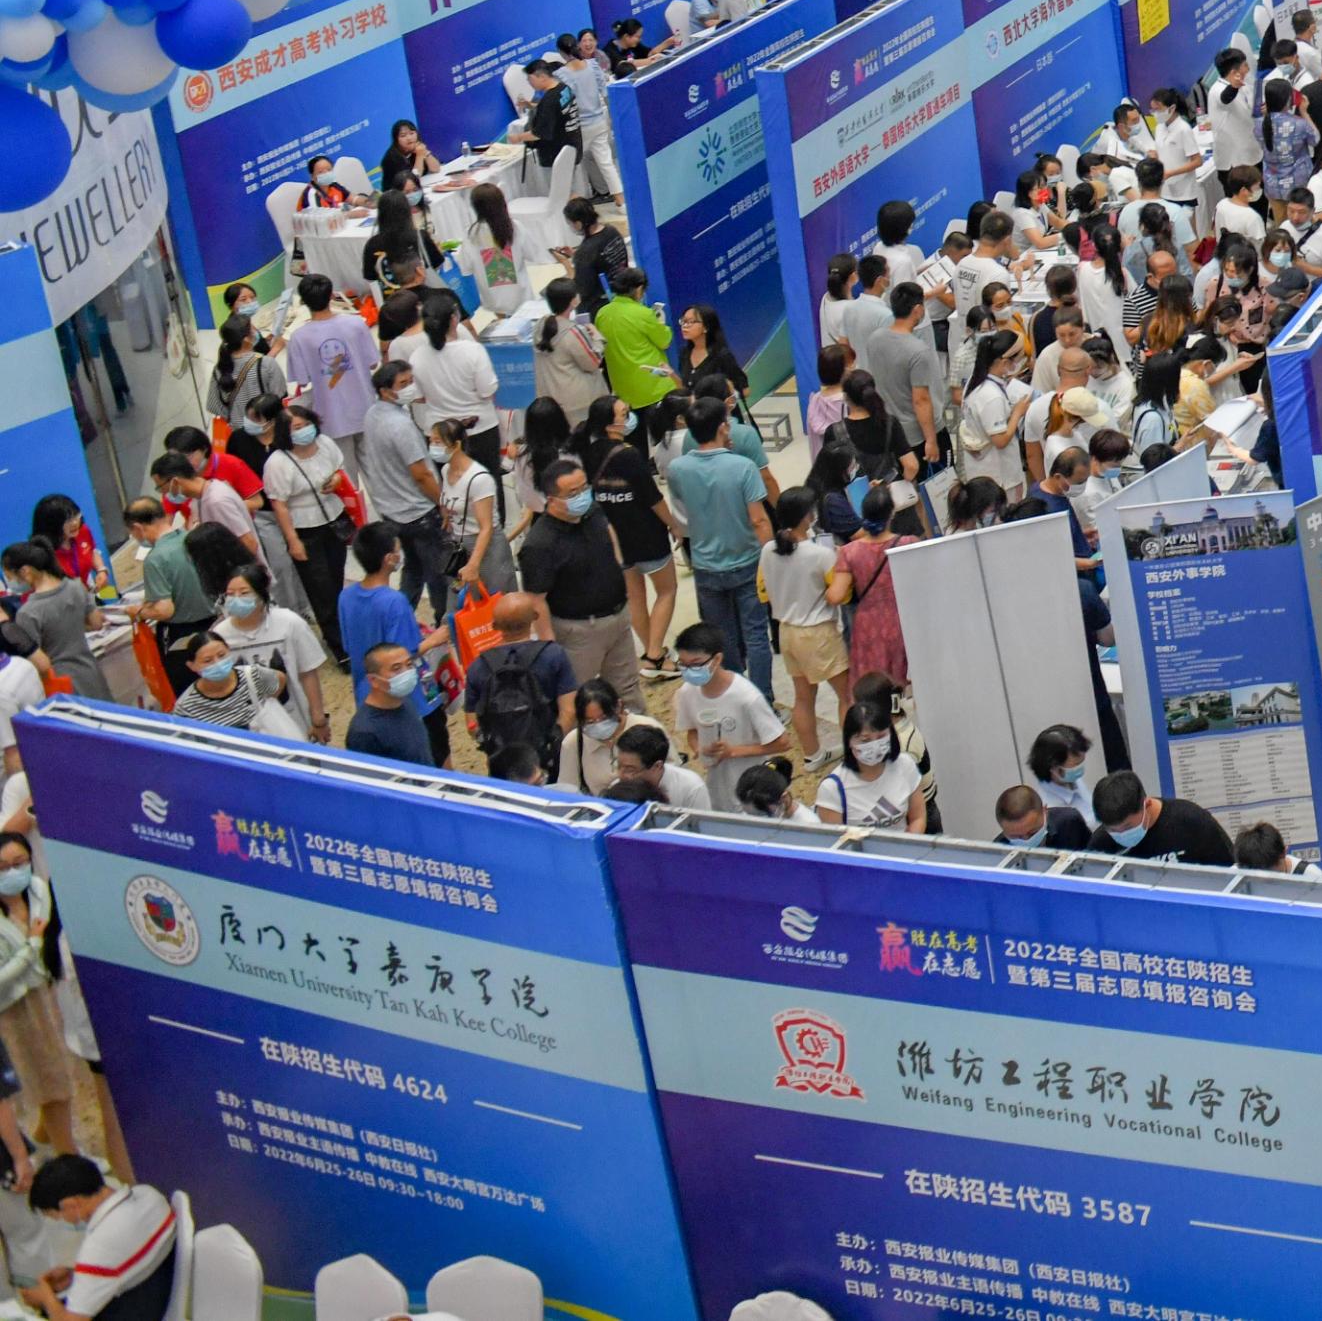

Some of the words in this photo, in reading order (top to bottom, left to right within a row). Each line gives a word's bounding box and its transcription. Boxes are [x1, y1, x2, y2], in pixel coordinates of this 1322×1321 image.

[217, 3, 389, 92] 西安成才高考补习学校
[24, 138, 156, 285] EWELLERY
[1145, 564, 1227, 585] 西安外事学院
[210, 810, 250, 862] 赢
[247, 837, 293, 869] 在志愿
[304, 832, 495, 890] 2022年全国高校在陕招生
[310, 857, 500, 914] 暨第三届志愿填报咨询会
[217, 904, 550, 1018] 厦门大学嘉庚学院
[876, 922, 923, 978] 赢
[921, 949, 983, 980] 在志愿
[1003, 939, 1255, 988] 2022年全国高校在陕招生
[225, 951, 288, 986] Xiamen
[291, 966, 375, 1010] University
[377, 986, 410, 1016] Tan
[413, 994, 450, 1026] Kah
[453, 1005, 487, 1034] Kee
[489, 1014, 558, 1053] College
[1007, 966, 1258, 1015] 暨第三届志愿填报咨询会
[259, 1036, 388, 1093] 在陕招生代码
[392, 1072, 450, 1107] 4624
[897, 1038, 1282, 1129] 潍坊工程职业学院
[901, 1085, 975, 1113] Weifang
[984, 1095, 1093, 1129] Engineering
[1102, 1112, 1202, 1142] Vocational
[1213, 1127, 1285, 1155] College
[904, 1168, 1072, 1220] 在陕招生代码
[1082, 1194, 1152, 1229] 3587
[1031, 1286, 1101, 1313] 中教在线
